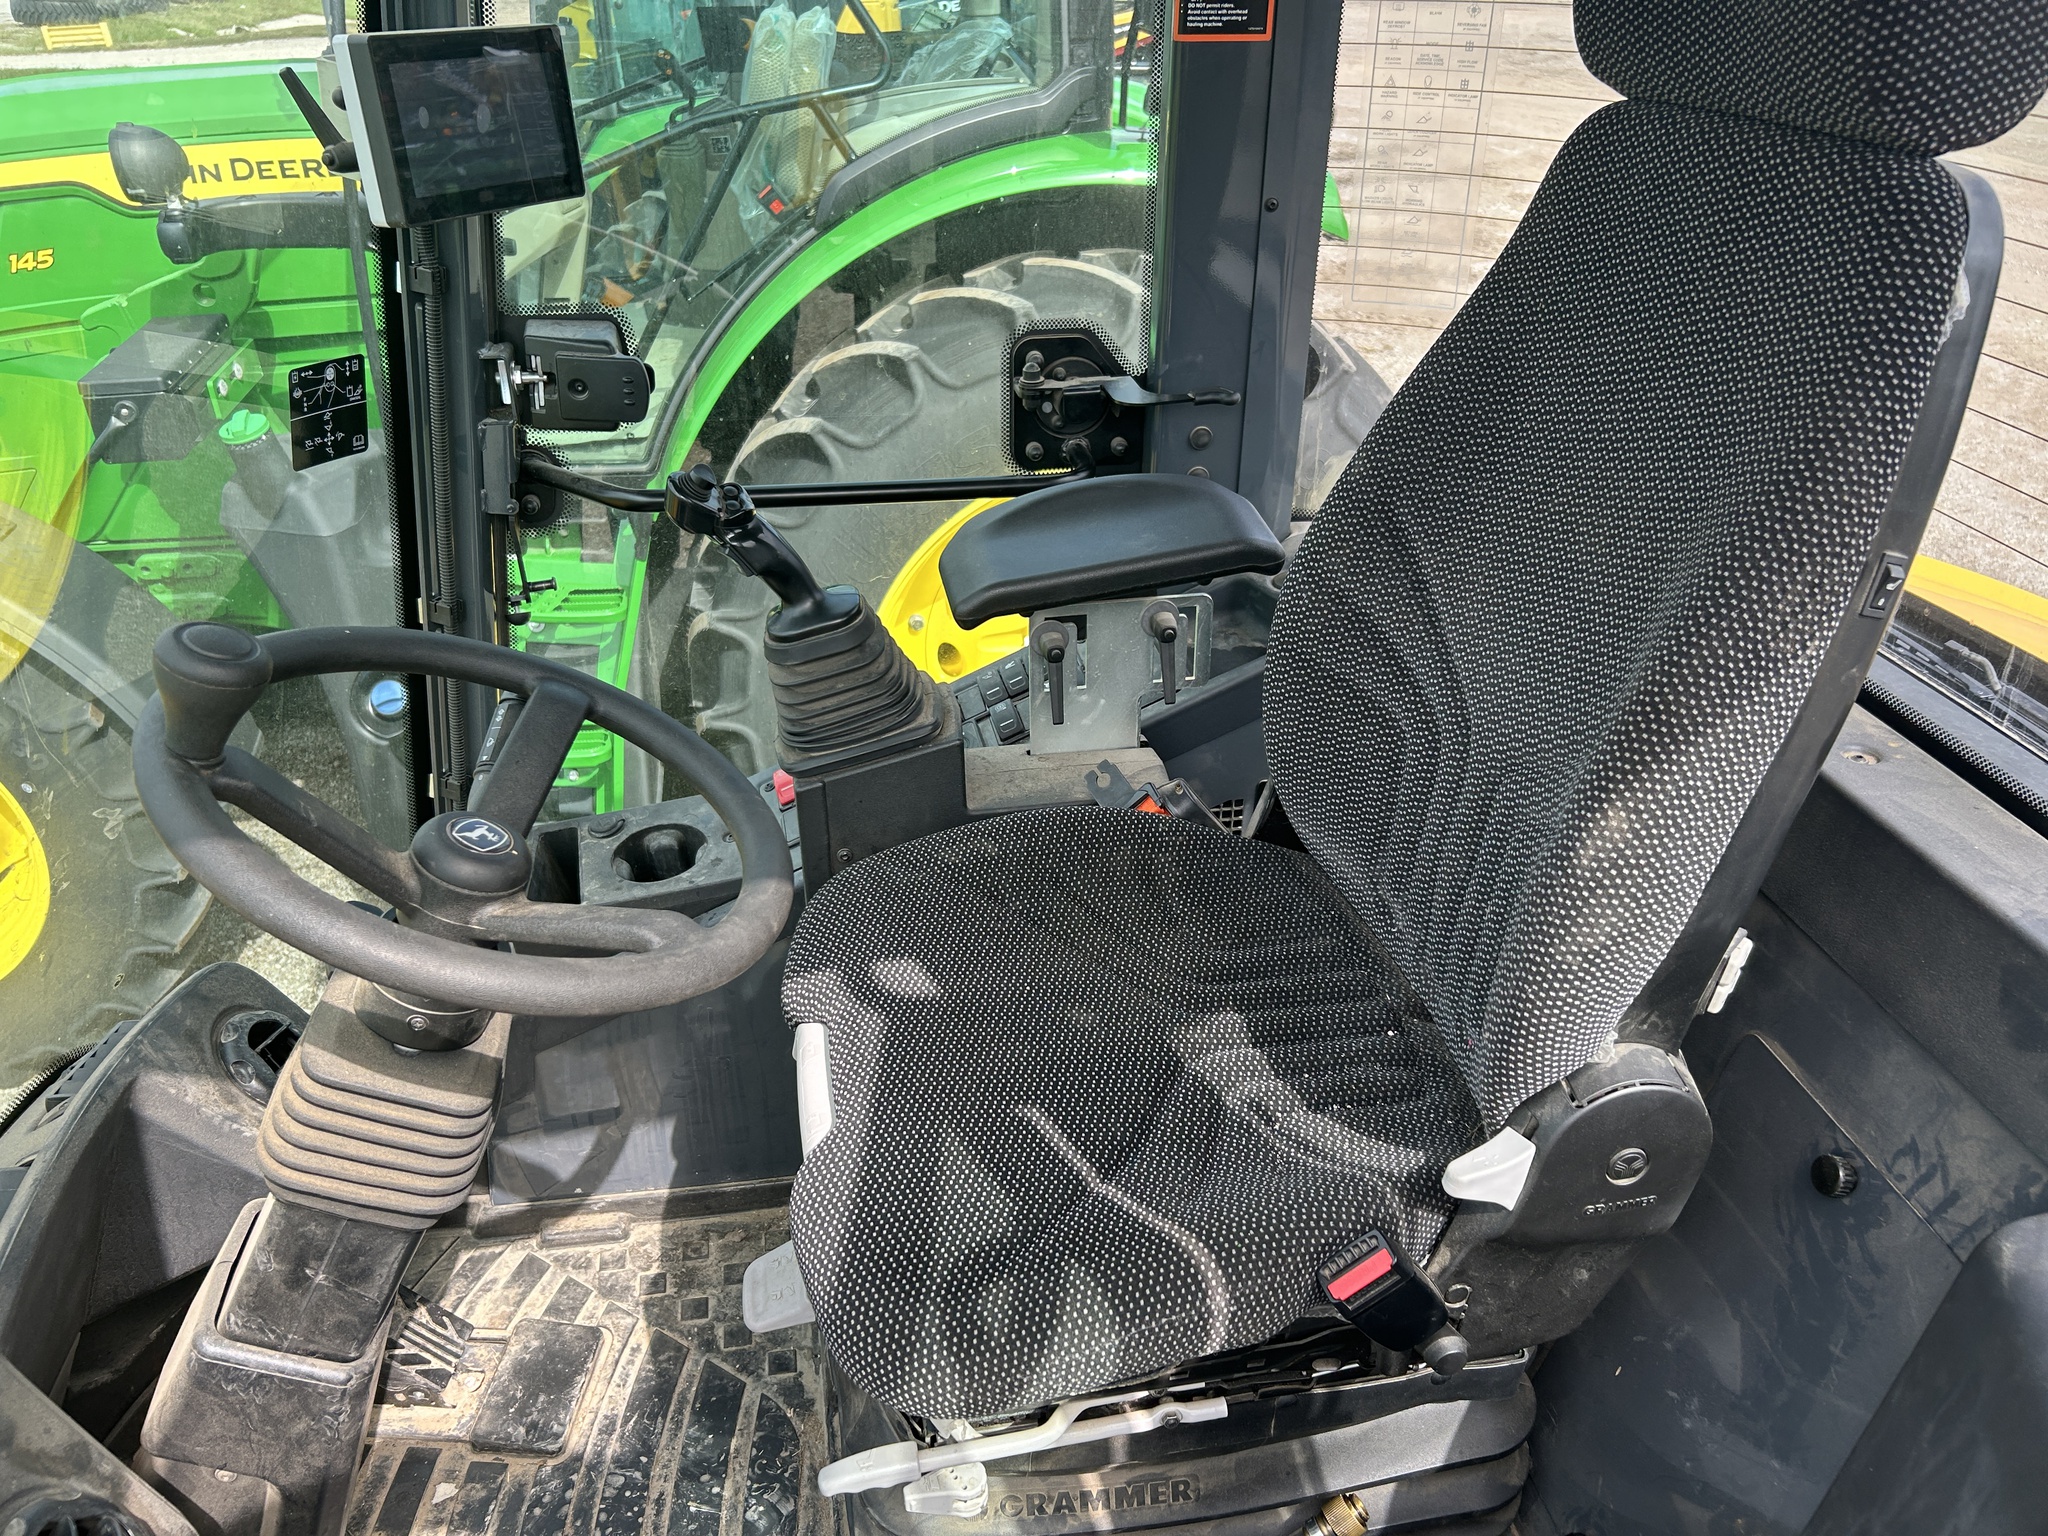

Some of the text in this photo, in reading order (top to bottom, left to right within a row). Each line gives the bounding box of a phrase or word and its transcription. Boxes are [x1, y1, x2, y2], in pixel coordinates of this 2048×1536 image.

[229, 157, 341, 182] DEER
[9, 248, 55, 274] 145
[1582, 1195, 1657, 1216] GRAMMER
[1000, 1477, 1195, 1518] GRAMMER
